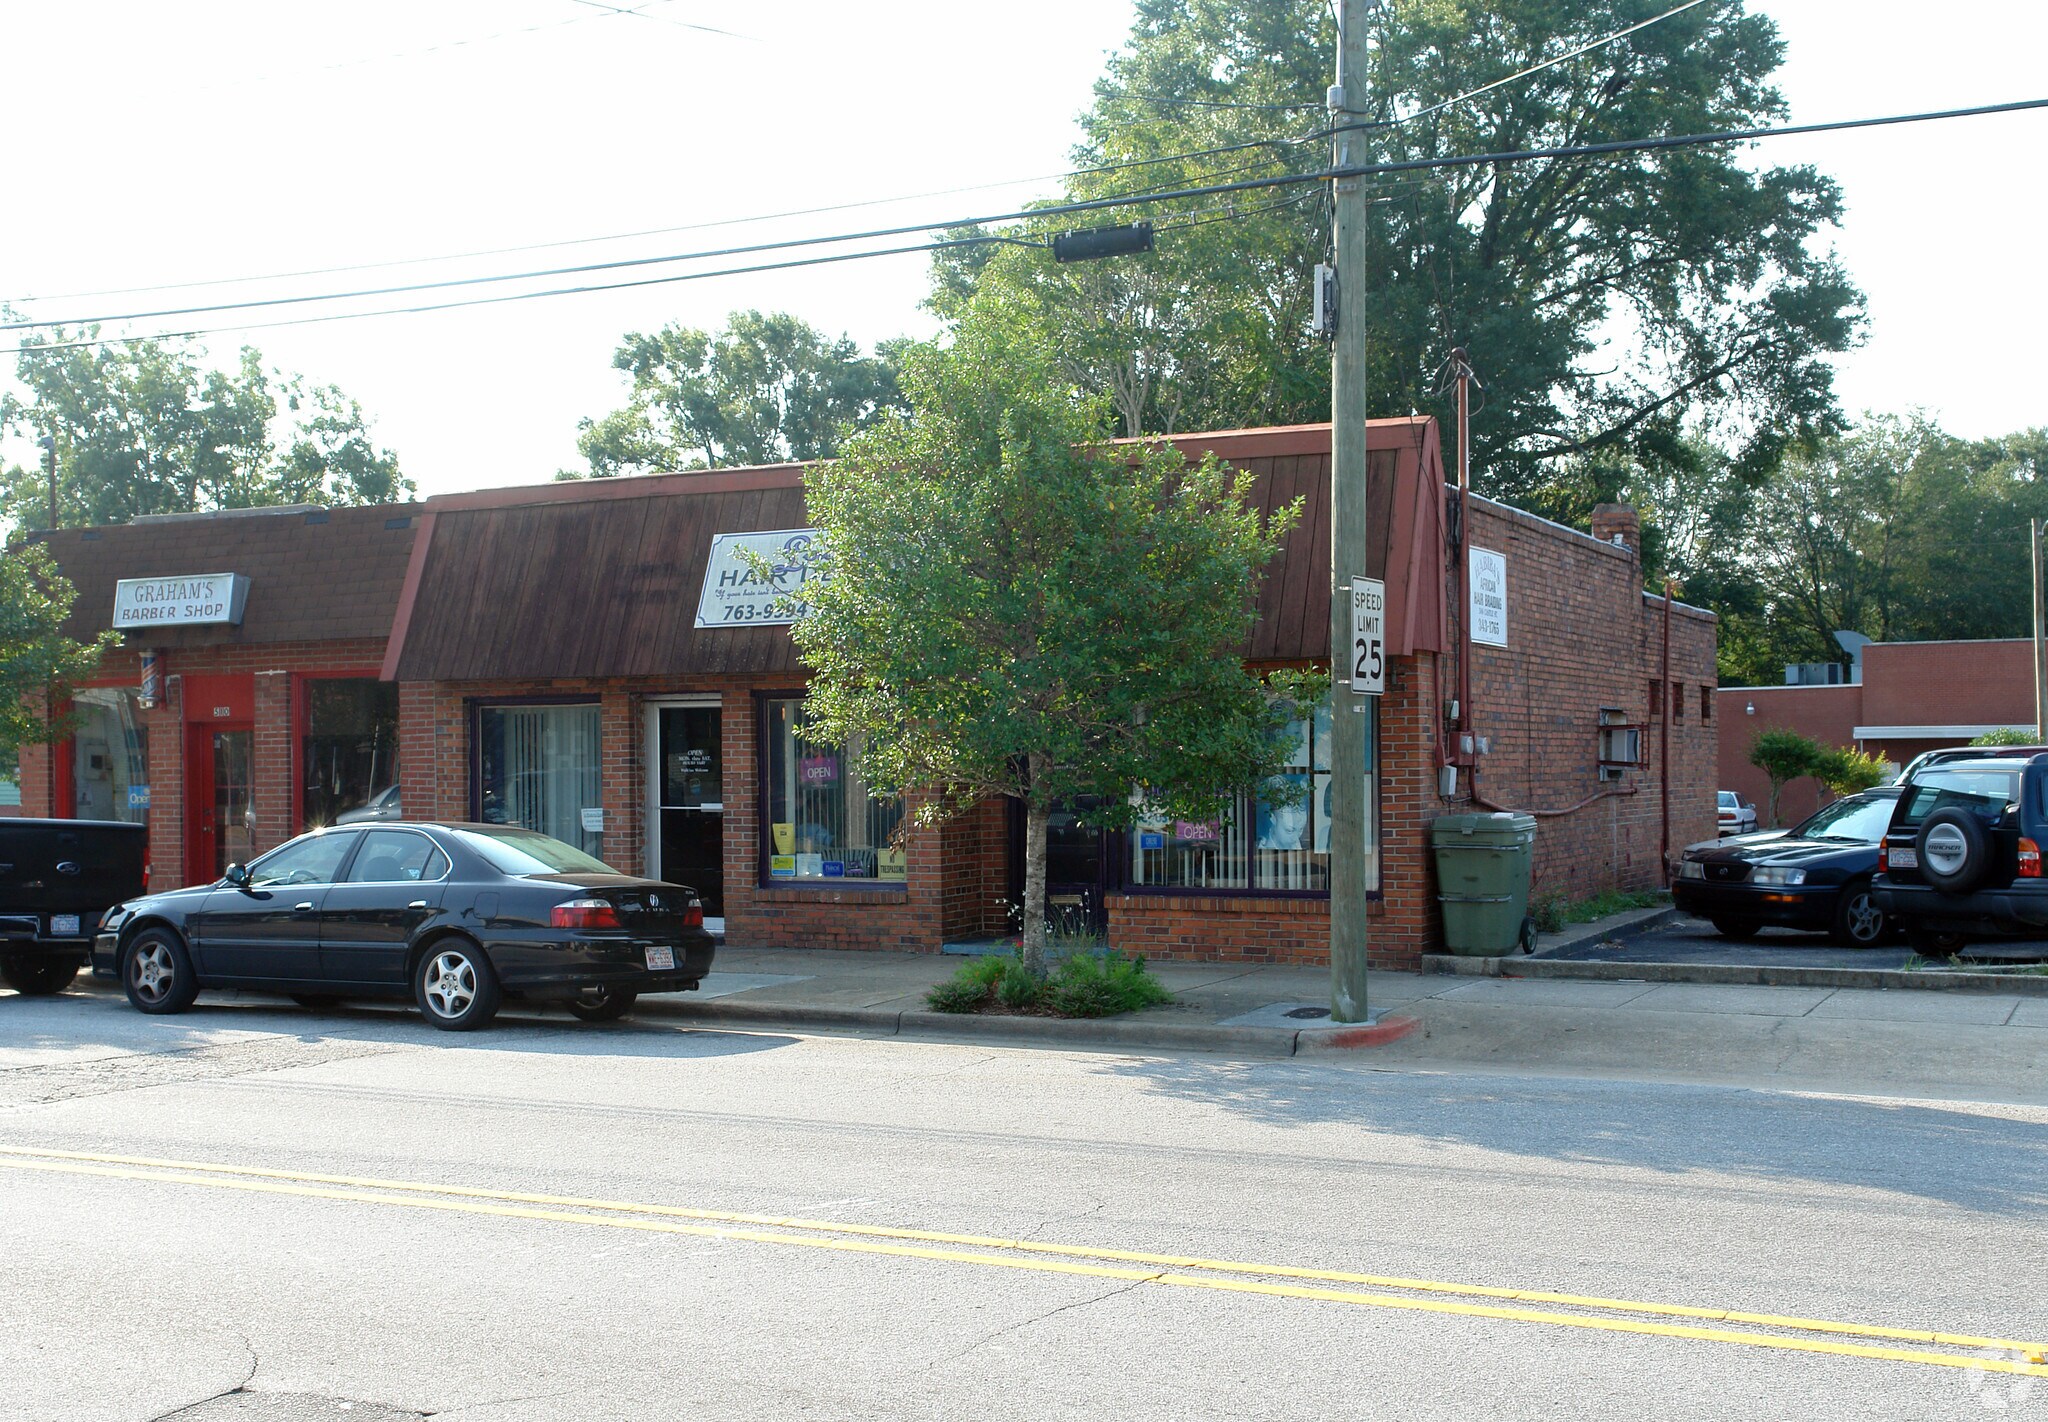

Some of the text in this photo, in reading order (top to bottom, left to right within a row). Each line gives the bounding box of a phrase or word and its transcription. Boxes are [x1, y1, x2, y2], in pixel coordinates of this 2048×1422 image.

[134, 581, 213, 603] GRAHAM'S
[1480, 577, 1496, 593] AFRICAN
[1354, 591, 1382, 611] SPEED
[1473, 592, 1484, 606] HAIR
[122, 603, 223, 620] BARBER SHOP
[1357, 615, 1379, 634] LIMIT
[1355, 638, 1382, 680] 25
[807, 766, 831, 779] OPEN
[1183, 826, 1212, 839] OPEN
[880, 865, 905, 873] TRESPASSING
